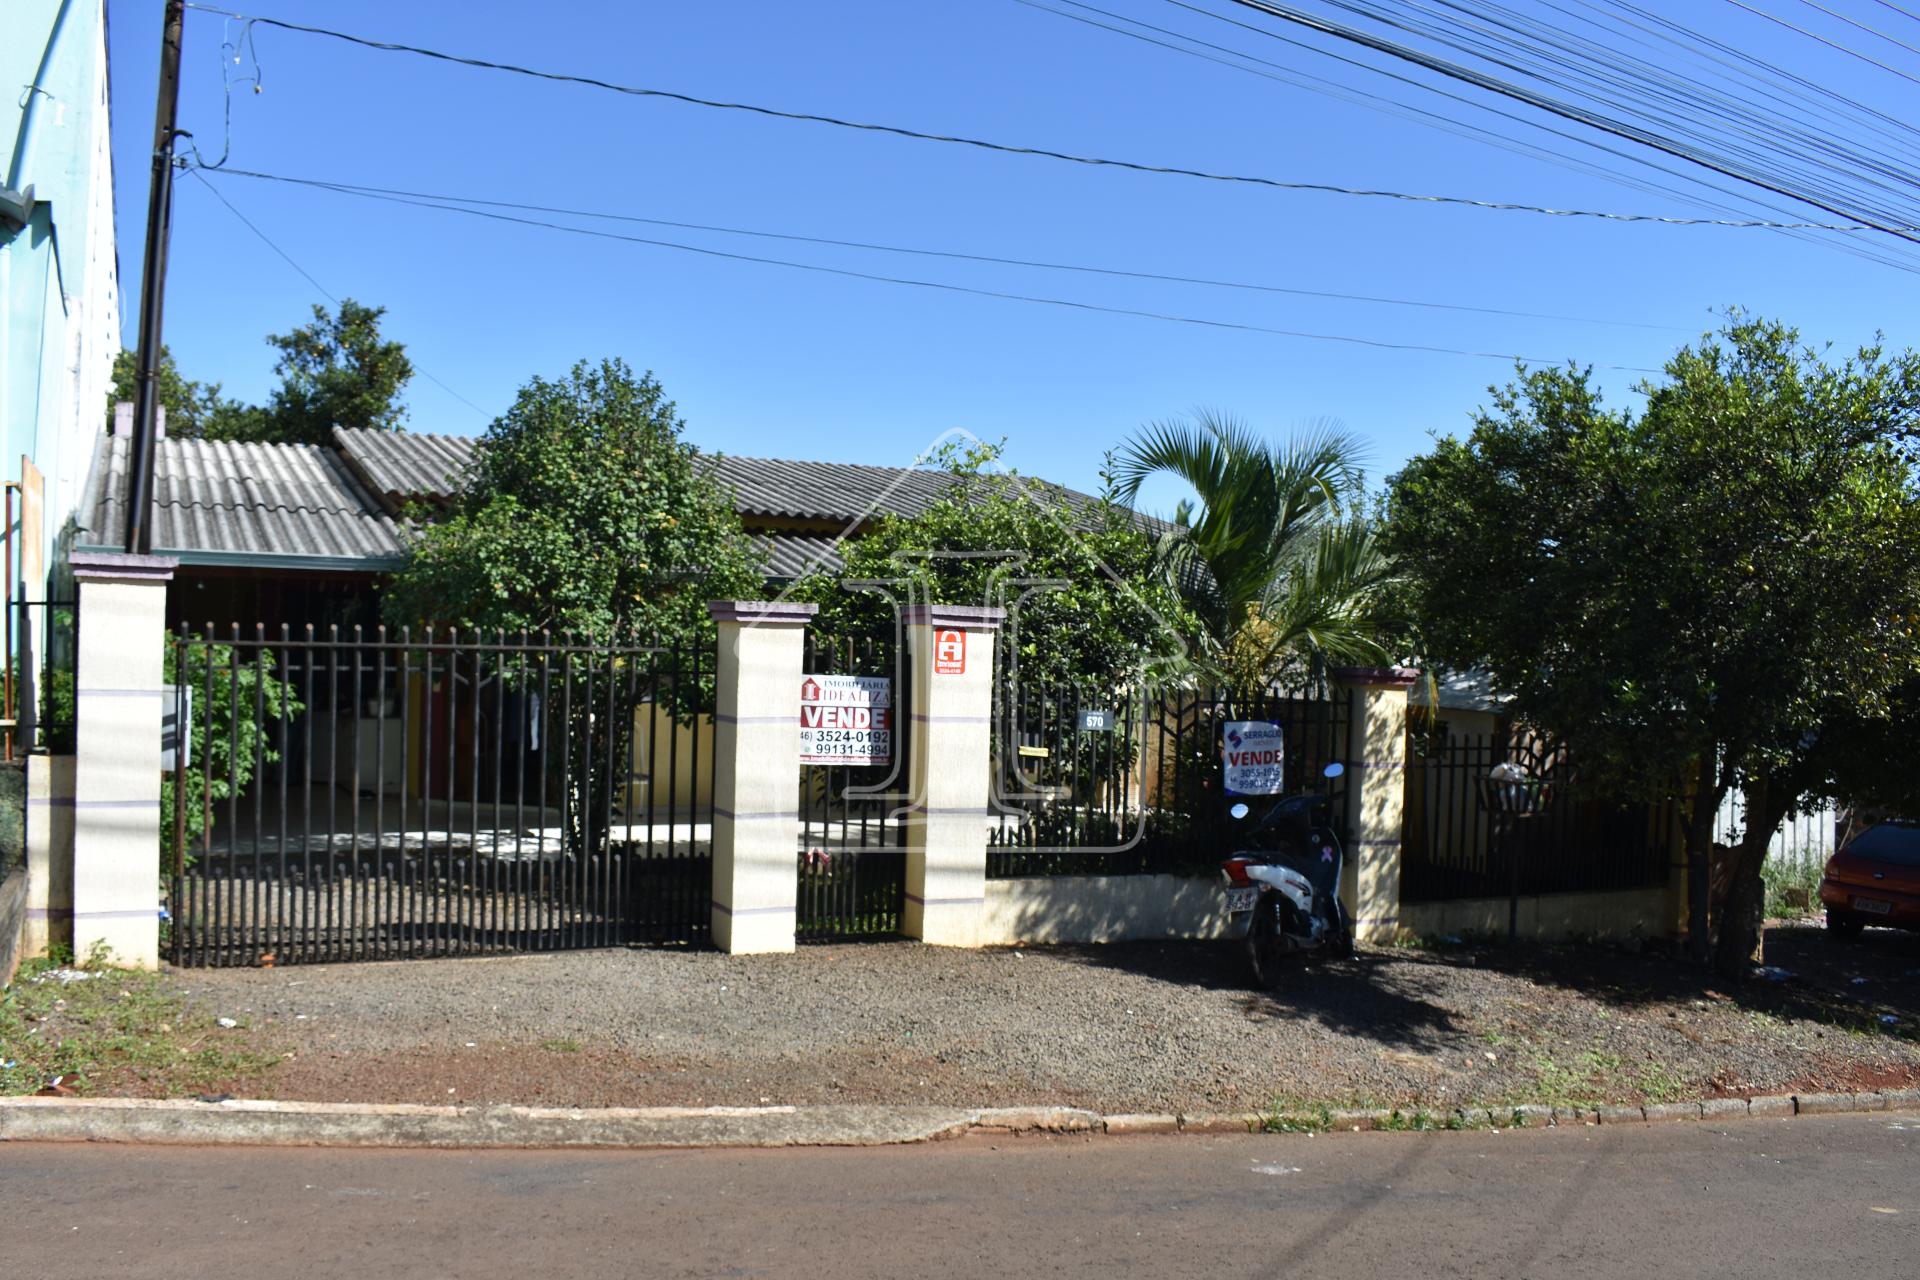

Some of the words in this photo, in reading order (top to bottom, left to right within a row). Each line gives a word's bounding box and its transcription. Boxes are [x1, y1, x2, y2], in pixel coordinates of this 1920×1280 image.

[823, 690, 889, 702] IDEALIZA
[804, 706, 885, 729] VENDE
[1086, 716, 1104, 727] 570
[800, 731, 813, 742] 46)
[816, 731, 889, 743] 3524-0192
[816, 743, 888, 755] 99131-4994
[1229, 750, 1281, 767] VENDE
